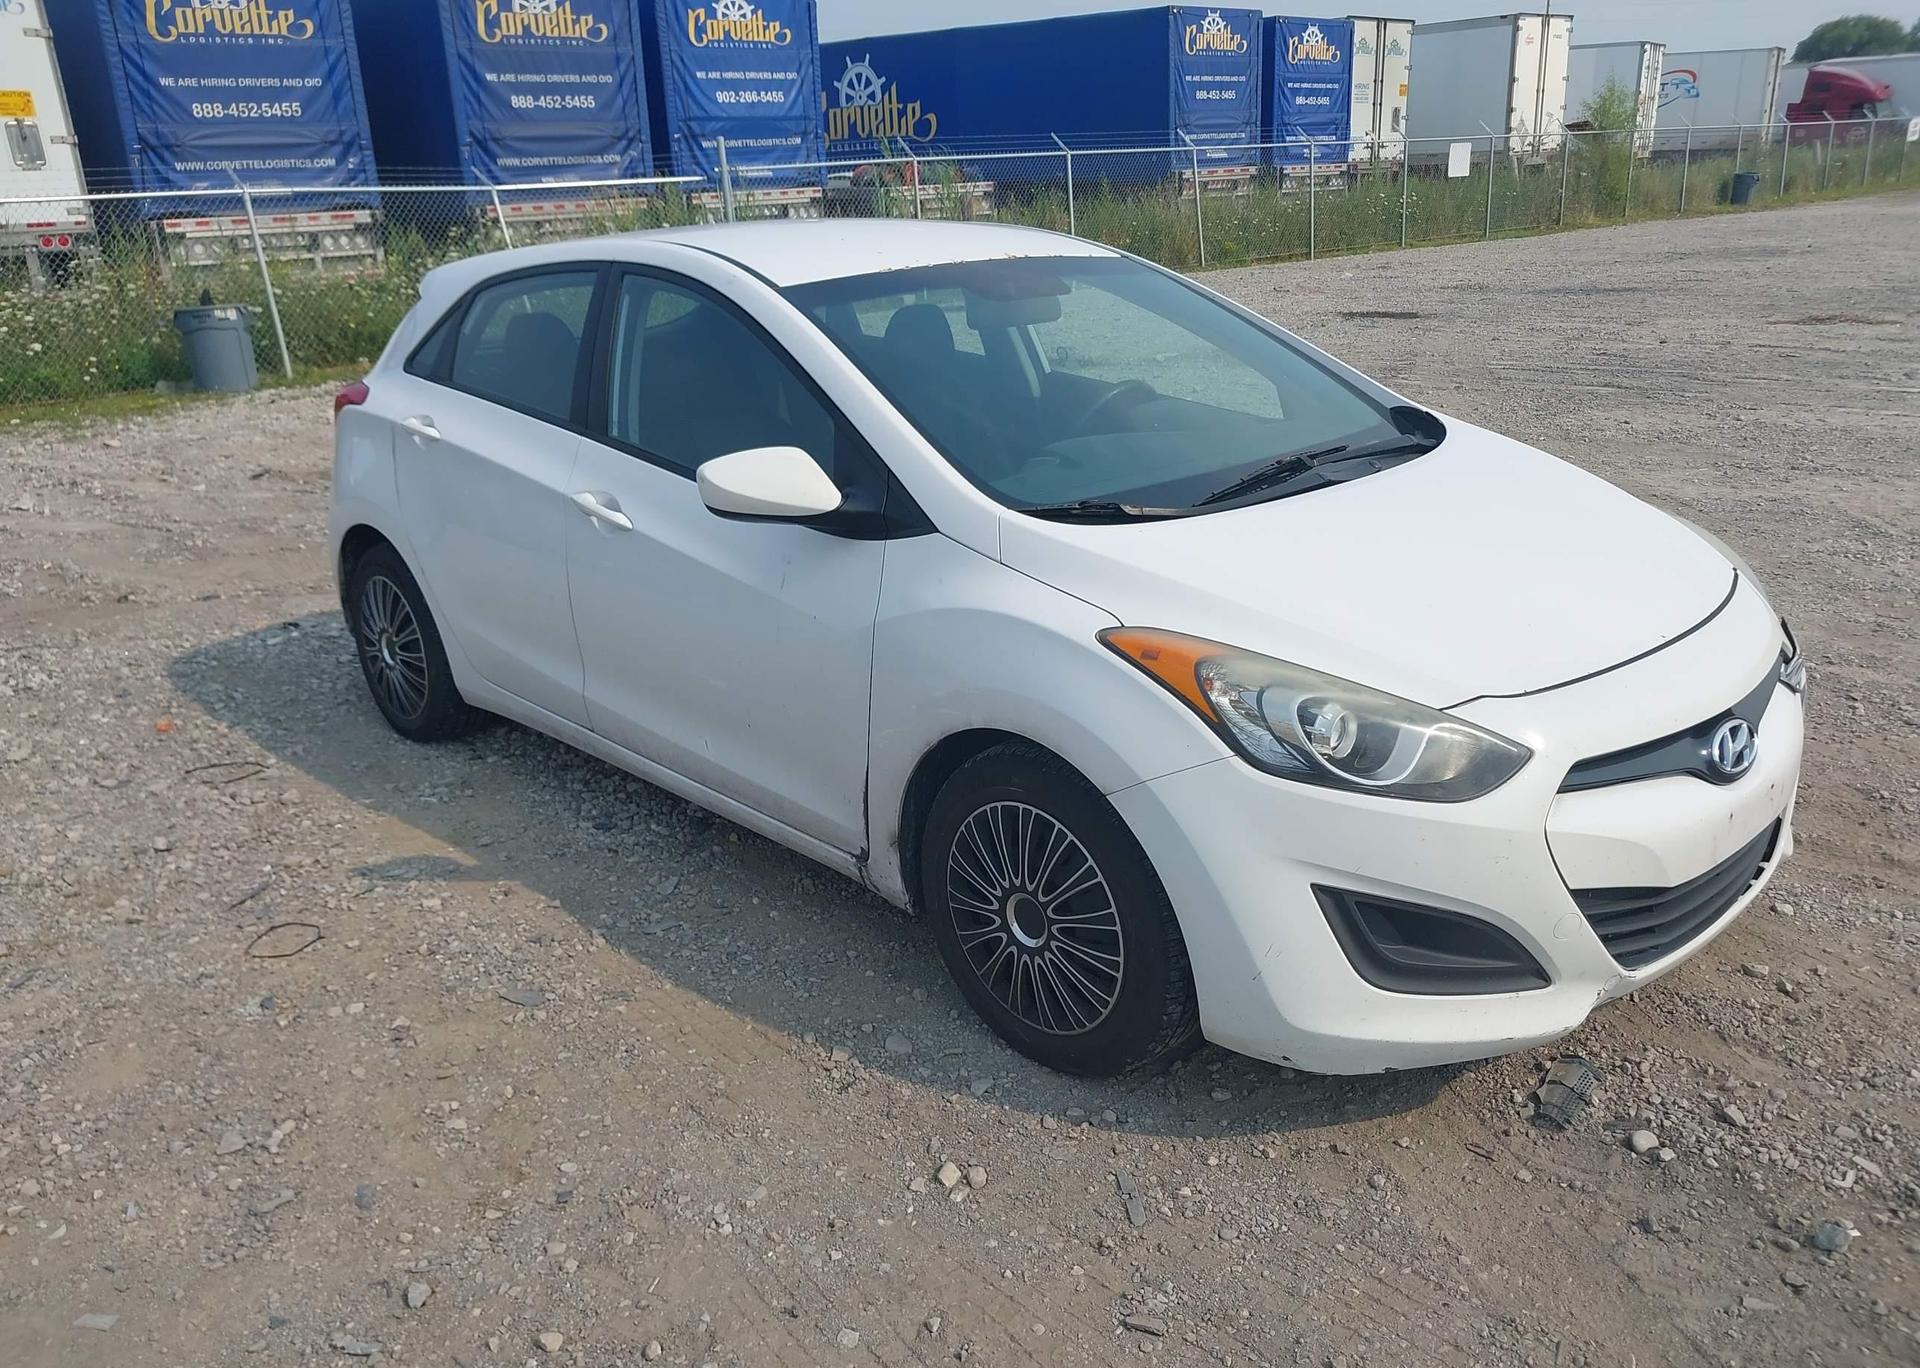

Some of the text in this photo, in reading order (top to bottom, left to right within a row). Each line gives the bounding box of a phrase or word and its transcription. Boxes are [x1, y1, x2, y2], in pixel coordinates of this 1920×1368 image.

[145, 0, 314, 42] Corvette
[475, 0, 608, 43] Corvette
[688, 8, 791, 47] Corvette
[180, 36, 253, 44] LOGISTICS
[503, 38, 560, 46] LOGISTICS
[1185, 24, 1247, 55] Corvette
[1288, 36, 1340, 64] Corvette
[159, 77, 176, 87] WE
[177, 77, 198, 87] ARE
[200, 77, 237, 87] HIRING
[238, 77, 280, 87] DRIVERS
[282, 77, 302, 87] AND
[485, 73, 498, 82] WE
[499, 73, 515, 82] ARE
[517, 74, 545, 82] HIRING
[547, 74, 580, 83] DRIVERS
[581, 75, 597, 83] AND
[511, 95, 596, 109] 888-452-5455
[715, 91, 785, 103] 902-266-5455
[192, 102, 302, 118] 888-452-5455
[821, 81, 938, 150] orvette
[175, 158, 336, 171] WWW.CORVETTELOGISTICS.COM
